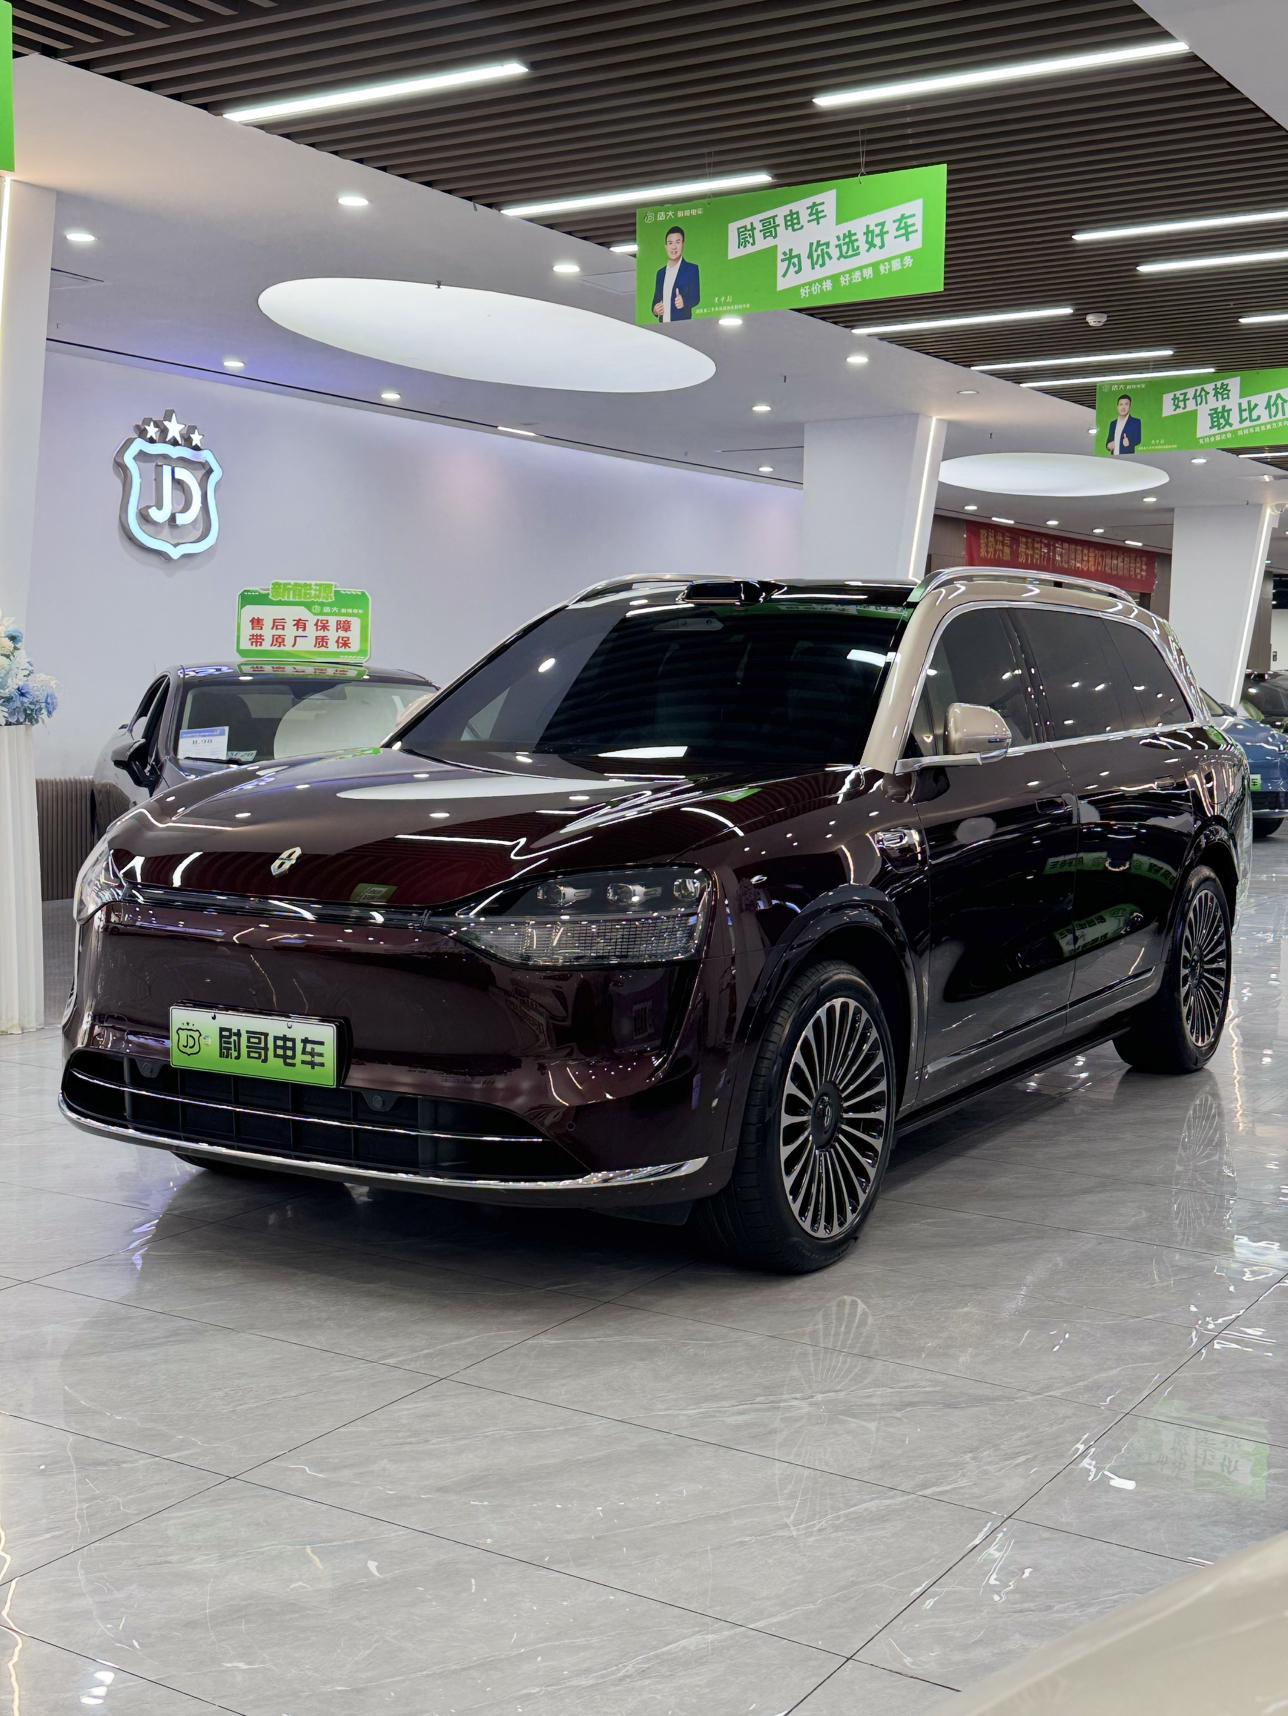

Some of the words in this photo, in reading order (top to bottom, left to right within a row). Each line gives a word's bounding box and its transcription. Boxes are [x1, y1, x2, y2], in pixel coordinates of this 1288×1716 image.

[736, 201, 827, 249] 尉哥电车
[780, 213, 918, 278] 为你选好车
[800, 280, 832, 299] 好价格
[840, 267, 873, 287] 好透明
[880, 255, 914, 275] 好服务
[1171, 382, 1231, 411] 好价格
[1207, 392, 1287, 430] 敢比价
[148, 464, 202, 525] JD
[249, 617, 352, 633] 售后有保障
[249, 633, 352, 649] 带原厂质保
[218, 1026, 326, 1070] 尉哥电车
